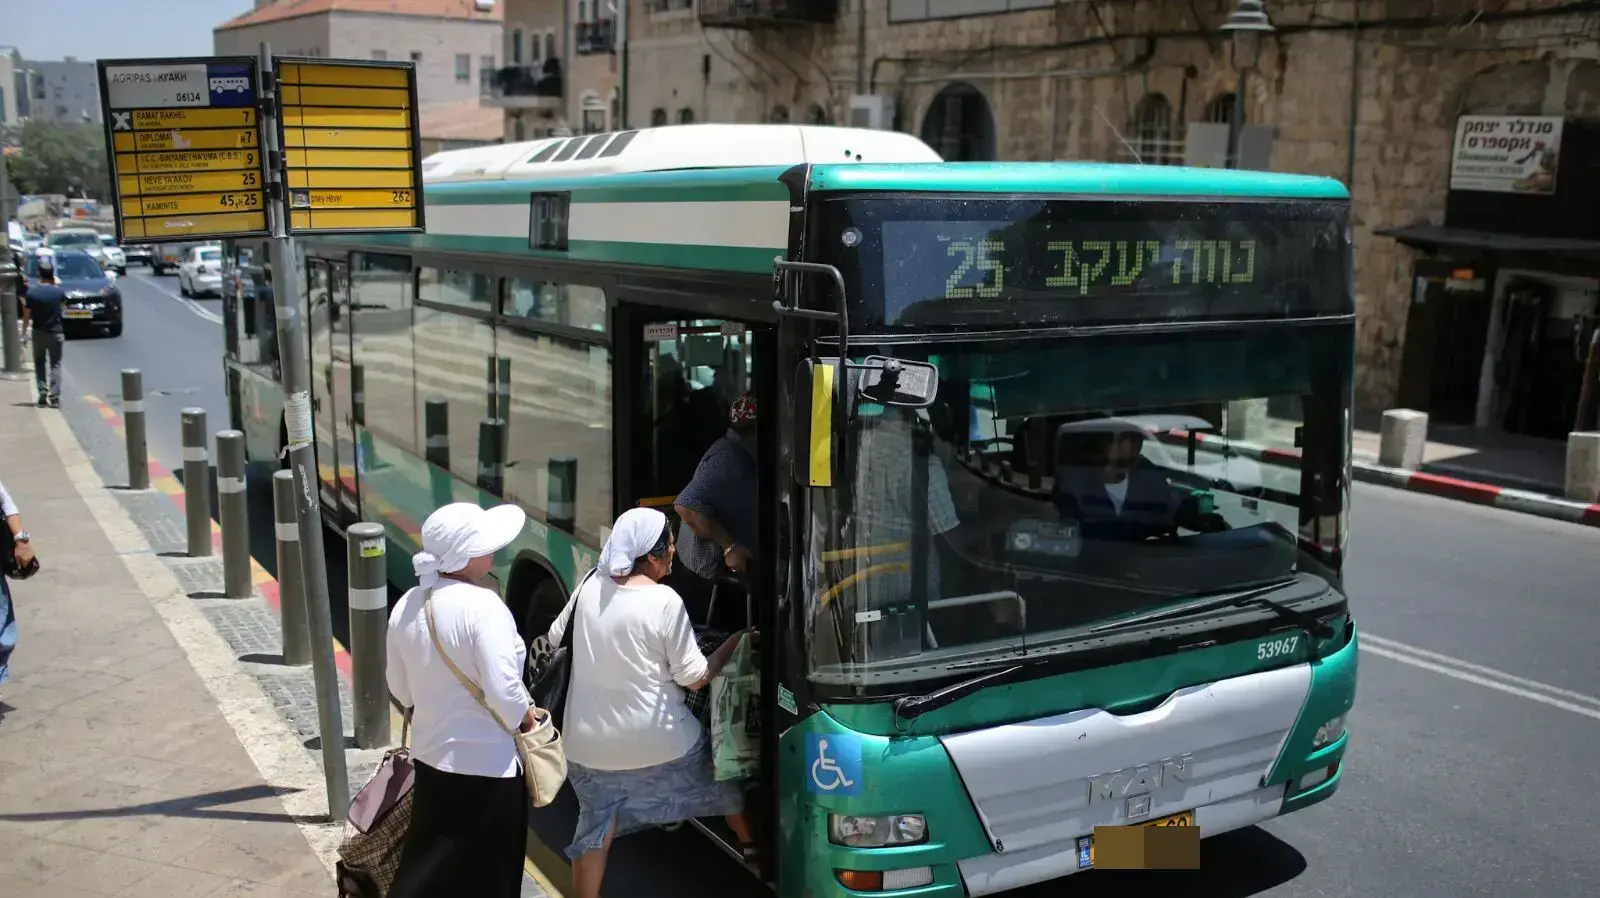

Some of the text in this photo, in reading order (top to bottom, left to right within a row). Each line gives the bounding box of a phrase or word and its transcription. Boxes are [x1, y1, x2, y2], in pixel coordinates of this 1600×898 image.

[112, 72, 152, 84] AGRIPAS
[176, 92, 201, 102] 06134
[242, 111, 249, 124] 7
[1468, 136, 1532, 152] אקספרס
[247, 153, 254, 165] 9
[143, 175, 162, 185] NEVE
[241, 173, 256, 185] 25
[392, 190, 411, 202] 262
[945, 240, 1255, 298] נווה יעקב 25
[1257, 636, 1299, 660] 53967
[1087, 752, 1193, 806] MAN
